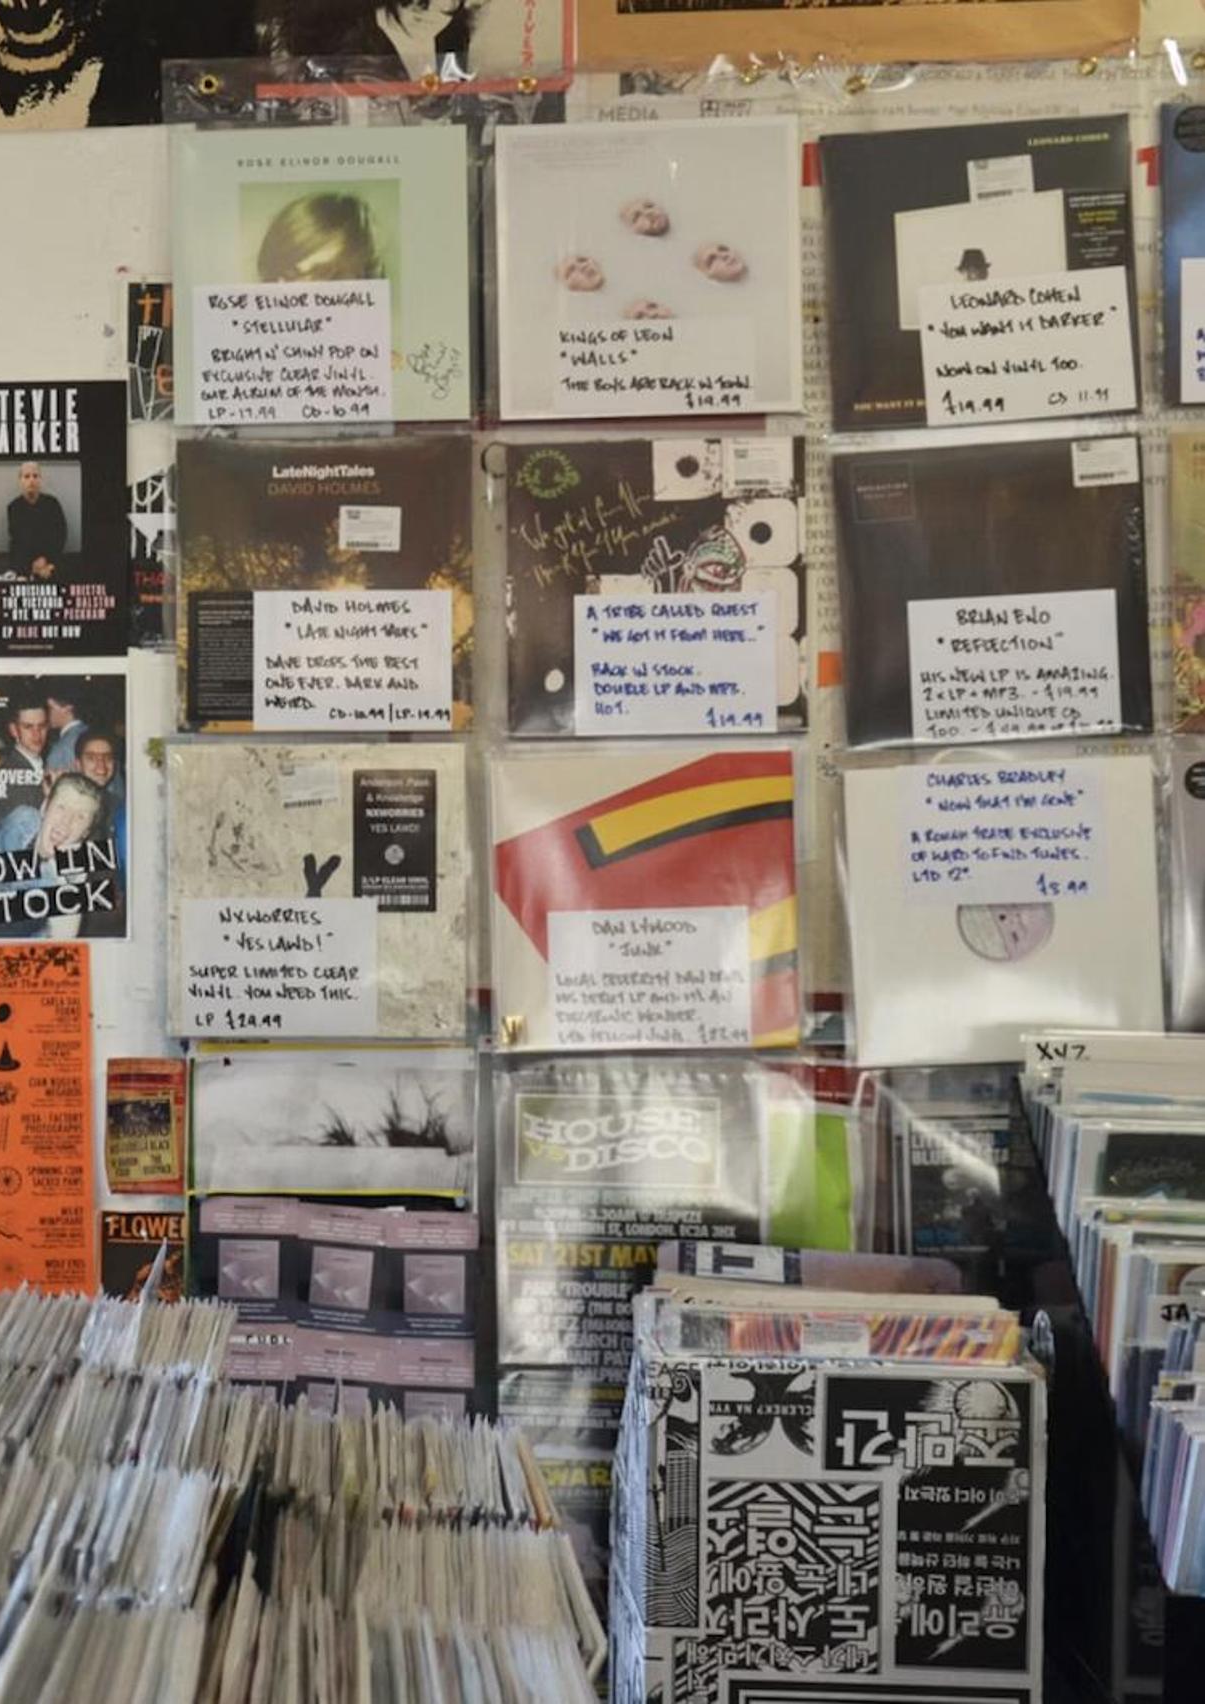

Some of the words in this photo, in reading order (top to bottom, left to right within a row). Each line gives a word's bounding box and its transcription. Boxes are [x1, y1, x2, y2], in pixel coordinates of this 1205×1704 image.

[208, 294, 248, 310] ROSE
[256, 292, 308, 310] ELINOR
[315, 291, 375, 307] DOUGALL
[950, 290, 1026, 310] LEONARD
[1029, 285, 1081, 306] COHEN
[559, 330, 607, 346] KINGS
[610, 329, 628, 342] OF
[634, 326, 674, 342] LEON
[970, 319, 1014, 338] WANT
[1018, 318, 1034, 333] IT
[329, 345, 354, 359] POP
[360, 344, 379, 358] ON
[202, 365, 273, 383] EXCLUSIVE
[936, 364, 973, 378] NOW
[976, 362, 997, 376] ON
[1001, 358, 1045, 375] VINYL
[233, 385, 281, 400] ALBUM
[287, 386, 301, 399] OF
[305, 385, 327, 399] THE
[561, 376, 589, 391] THE
[660, 377, 695, 391] BACK
[698, 376, 712, 388] IN
[272, 464, 375, 480] LateNightTales
[268, 482, 312, 496] DAVID
[317, 481, 381, 495] HOLMES
[292, 597, 338, 614] DAVID
[345, 600, 411, 613] HOLMES
[586, 605, 597, 620] A
[603, 604, 646, 619] TRIBE
[651, 603, 705, 618] CALLED
[710, 601, 759, 617] QUEST
[956, 607, 1008, 626] BRIAN
[1013, 604, 1051, 624] ENO
[654, 629, 666, 642] IT
[266, 655, 301, 670] DAVE
[351, 654, 378, 670] THE
[385, 656, 419, 670] BEST
[632, 661, 648, 677] IN
[266, 674, 293, 690] ONE
[386, 676, 419, 691] AND
[920, 669, 946, 684] HIS
[950, 667, 986, 683] NEW
[989, 668, 1009, 682] LP
[1015, 668, 1030, 681] IS
[594, 681, 649, 696] DOUBLE
[653, 682, 672, 695] LP
[674, 681, 705, 696] AND
[925, 704, 991, 721] LIMITED
[996, 703, 1057, 719] UNIQUE
[926, 771, 992, 787] CHARLES
[997, 769, 1065, 785] BRADLEY
[55, 838, 117, 875] IN
[220, 906, 322, 926] NXWORRIES
[189, 965, 238, 979] SUPER
[244, 964, 308, 979] LIMITED
[313, 965, 360, 982] CLEAR
[245, 984, 272, 1000] YOU
[276, 983, 315, 1000] NEED
[195, 1012, 214, 1027] LP
[523, 1107, 702, 1145] HOUSE
[564, 1135, 713, 1171] DISCO
